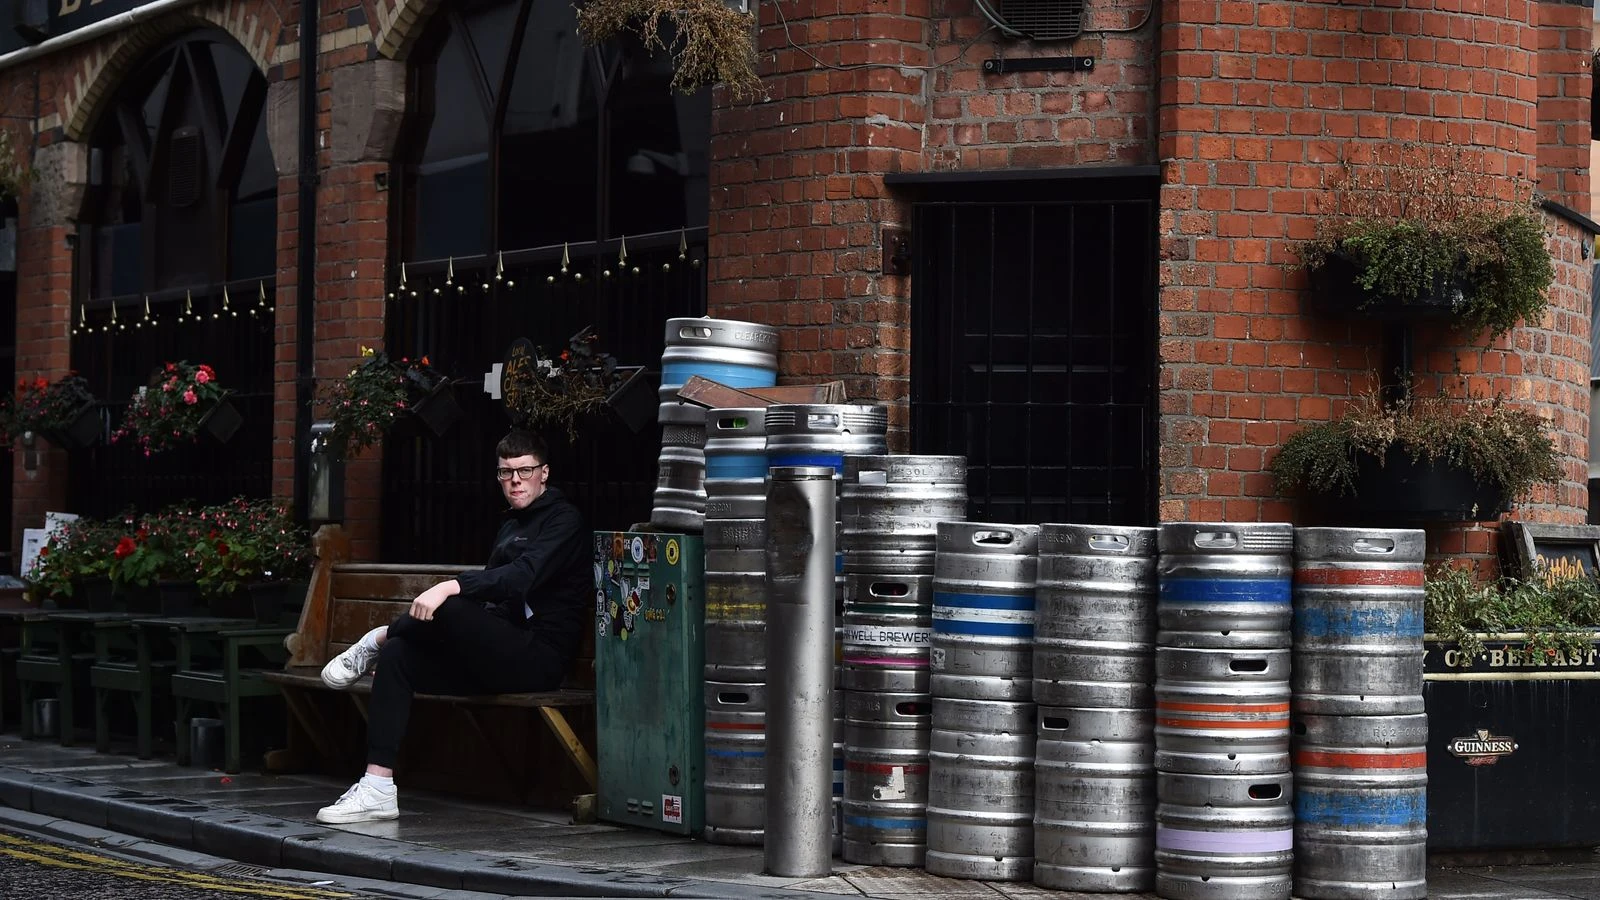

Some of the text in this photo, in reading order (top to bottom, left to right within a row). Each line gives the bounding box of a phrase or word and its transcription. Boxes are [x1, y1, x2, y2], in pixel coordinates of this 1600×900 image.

[879, 631, 931, 643] BREWER
[1489, 649, 1597, 666] BELAST
[1454, 741, 1512, 753] GUINNESS
